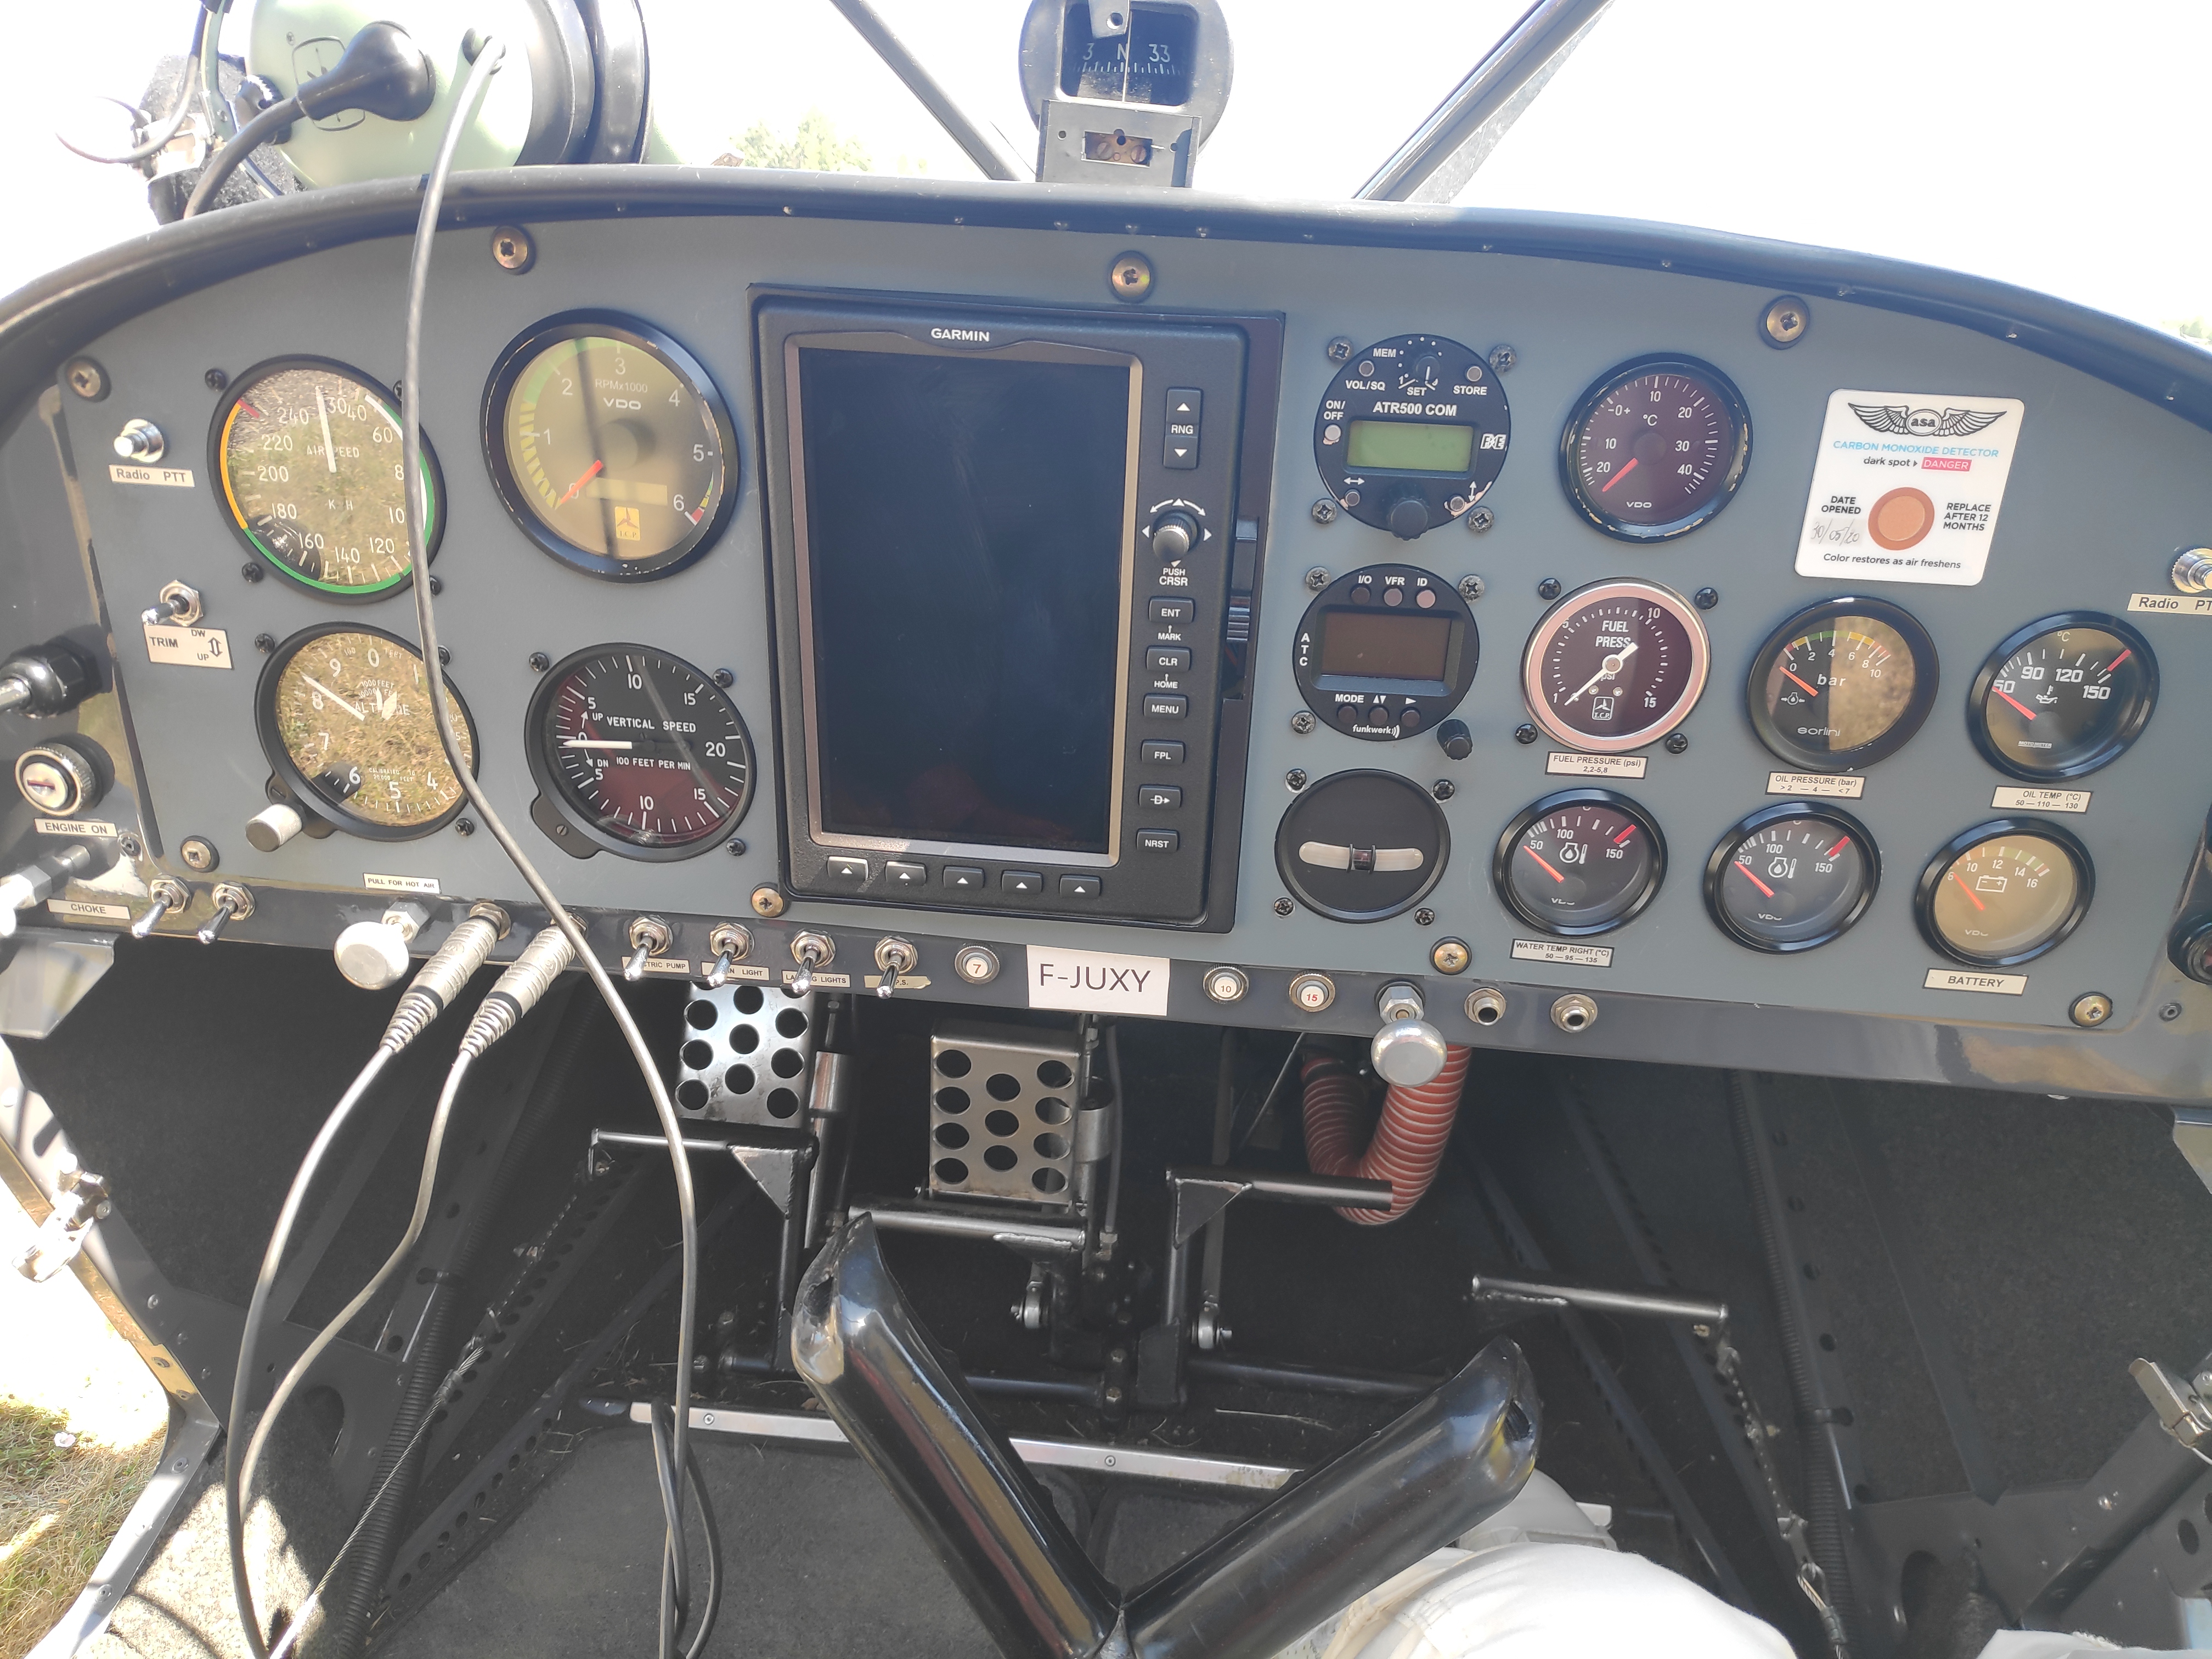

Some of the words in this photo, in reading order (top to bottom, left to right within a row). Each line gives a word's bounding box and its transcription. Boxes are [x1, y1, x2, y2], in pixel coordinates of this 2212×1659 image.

[1117, 43, 1128, 60] N
[1148, 44, 1170, 63] 33
[931, 328, 989, 341] GARMIN
[1373, 348, 1396, 357] MEM
[615, 358, 625, 375] 3
[562, 379, 572, 395] 2
[595, 379, 647, 393] RPMx1000
[1345, 380, 1385, 391] VOL/SQ
[1453, 386, 1487, 395] STORE
[1407, 387, 1427, 396] SET
[1650, 391, 1661, 402] 10
[603, 398, 641, 410] VDO
[669, 391, 680, 406] 4
[328, 397, 347, 413] 30
[1326, 400, 1345, 409] ON/
[1373, 402, 1422, 415] ATR500
[1425, 404, 1457, 416] COM
[277, 407, 309, 425] 240
[348, 405, 366, 421] 40
[1678, 407, 1692, 418] 20
[1643, 414, 1658, 426] °C
[1911, 417, 1936, 427] asa
[373, 427, 393, 443] 60
[1171, 425, 1193, 434] RNG
[544, 429, 550, 444] 1
[262, 436, 293, 451] 220
[1605, 438, 1616, 449] 10
[1675, 441, 1689, 452] 30
[307, 447, 359, 458] AIRPEED
[693, 444, 704, 461] 5
[1833, 441, 1878, 450] CARBON
[1882, 444, 1939, 454] MONOXIDE
[1942, 447, 1999, 458] DETECTOR
[1596, 462, 1610, 472] 20
[1864, 457, 1884, 465] dark
[1888, 458, 1910, 467] spot
[1923, 459, 1968, 469] DANGER
[116, 468, 150, 481] Radio
[163, 471, 186, 483] PTT
[258, 466, 289, 482] 200
[1677, 465, 1692, 475] 40
[674, 495, 684, 511] 6
[1831, 496, 1856, 505] DATE
[272, 504, 297, 520] 180
[1821, 505, 1861, 515] OPENED
[1947, 503, 1991, 512] REPLACE
[1944, 512, 1975, 521] AFTER
[1943, 522, 1985, 531] MONTHS
[299, 534, 324, 549] 160
[370, 538, 394, 553] 120
[335, 547, 360, 563] 140
[1824, 554, 1849, 563] Color
[1852, 555, 1890, 565] restores
[1905, 558, 1918, 566] air
[1921, 559, 1961, 569] freshens
[1159, 577, 1188, 586] CRSR
[1358, 575, 1372, 584] I/O
[1385, 577, 1405, 585] VFR
[1417, 578, 1427, 586] ID
[2138, 597, 2179, 609] Radio
[1161, 608, 1181, 617] ENT
[1648, 608, 1660, 618] 10
[1602, 620, 1629, 632] FUEL
[191, 629, 205, 637] DW
[1158, 633, 1181, 641] MARK
[2057, 631, 2070, 642] °C
[149, 636, 178, 648] TRIM
[1595, 636, 1631, 648] PRESS
[344, 647, 356, 656] 100
[1159, 657, 1178, 665] CLR
[1870, 669, 1881, 678] 10
[2021, 667, 2045, 680] 90
[2055, 669, 2083, 682] 120
[377, 680, 394, 689] FEET
[628, 674, 642, 689] 10
[1154, 680, 1178, 689] HOME
[1817, 674, 1846, 686] bar
[1993, 680, 2016, 693] 50
[2083, 685, 2111, 699] 150
[684, 692, 696, 706] 15
[1335, 695, 1364, 703] MODE
[1644, 697, 1656, 707] 15
[1152, 705, 1178, 713] MENU
[592, 713, 603, 721] UP
[607, 716, 654, 730] VERTICAL
[663, 721, 696, 732] SPEED
[1352, 725, 1391, 734] funkwerk
[706, 742, 726, 757] 20
[597, 759, 608, 768] DN
[616, 757, 629, 766] 100
[633, 758, 654, 768] FEET
[659, 760, 675, 769] PER
[678, 761, 691, 770] MIN
[1577, 757, 1621, 765] PRESSURE
[1623, 759, 1641, 767] (psi)
[1838, 778, 1857, 787] (bar)
[694, 788, 706, 800] 15
[640, 795, 653, 810] 10
[45, 823, 86, 833] ENGINE
[92, 825, 108, 834] ON
[1556, 830, 1573, 839] 100
[1145, 839, 1169, 848] NRST
[1530, 840, 1543, 850] 50
[1766, 844, 1783, 854] 100
[1606, 849, 1623, 859] 150
[1738, 855, 1752, 865] 50
[1993, 860, 2003, 869] 12
[1815, 862, 1832, 872] 150
[1966, 862, 1978, 872] 10
[2015, 867, 2025, 877] 14
[2027, 878, 2038, 888] 16
[71, 904, 106, 914] CHOKE
[1546, 945, 1567, 953] TEMP
[1570, 947, 1594, 955] RIGHT
[1040, 963, 1151, 992] F-JUXY
[1948, 976, 2004, 987] BATTERY
[1306, 992, 1318, 1002] 15
